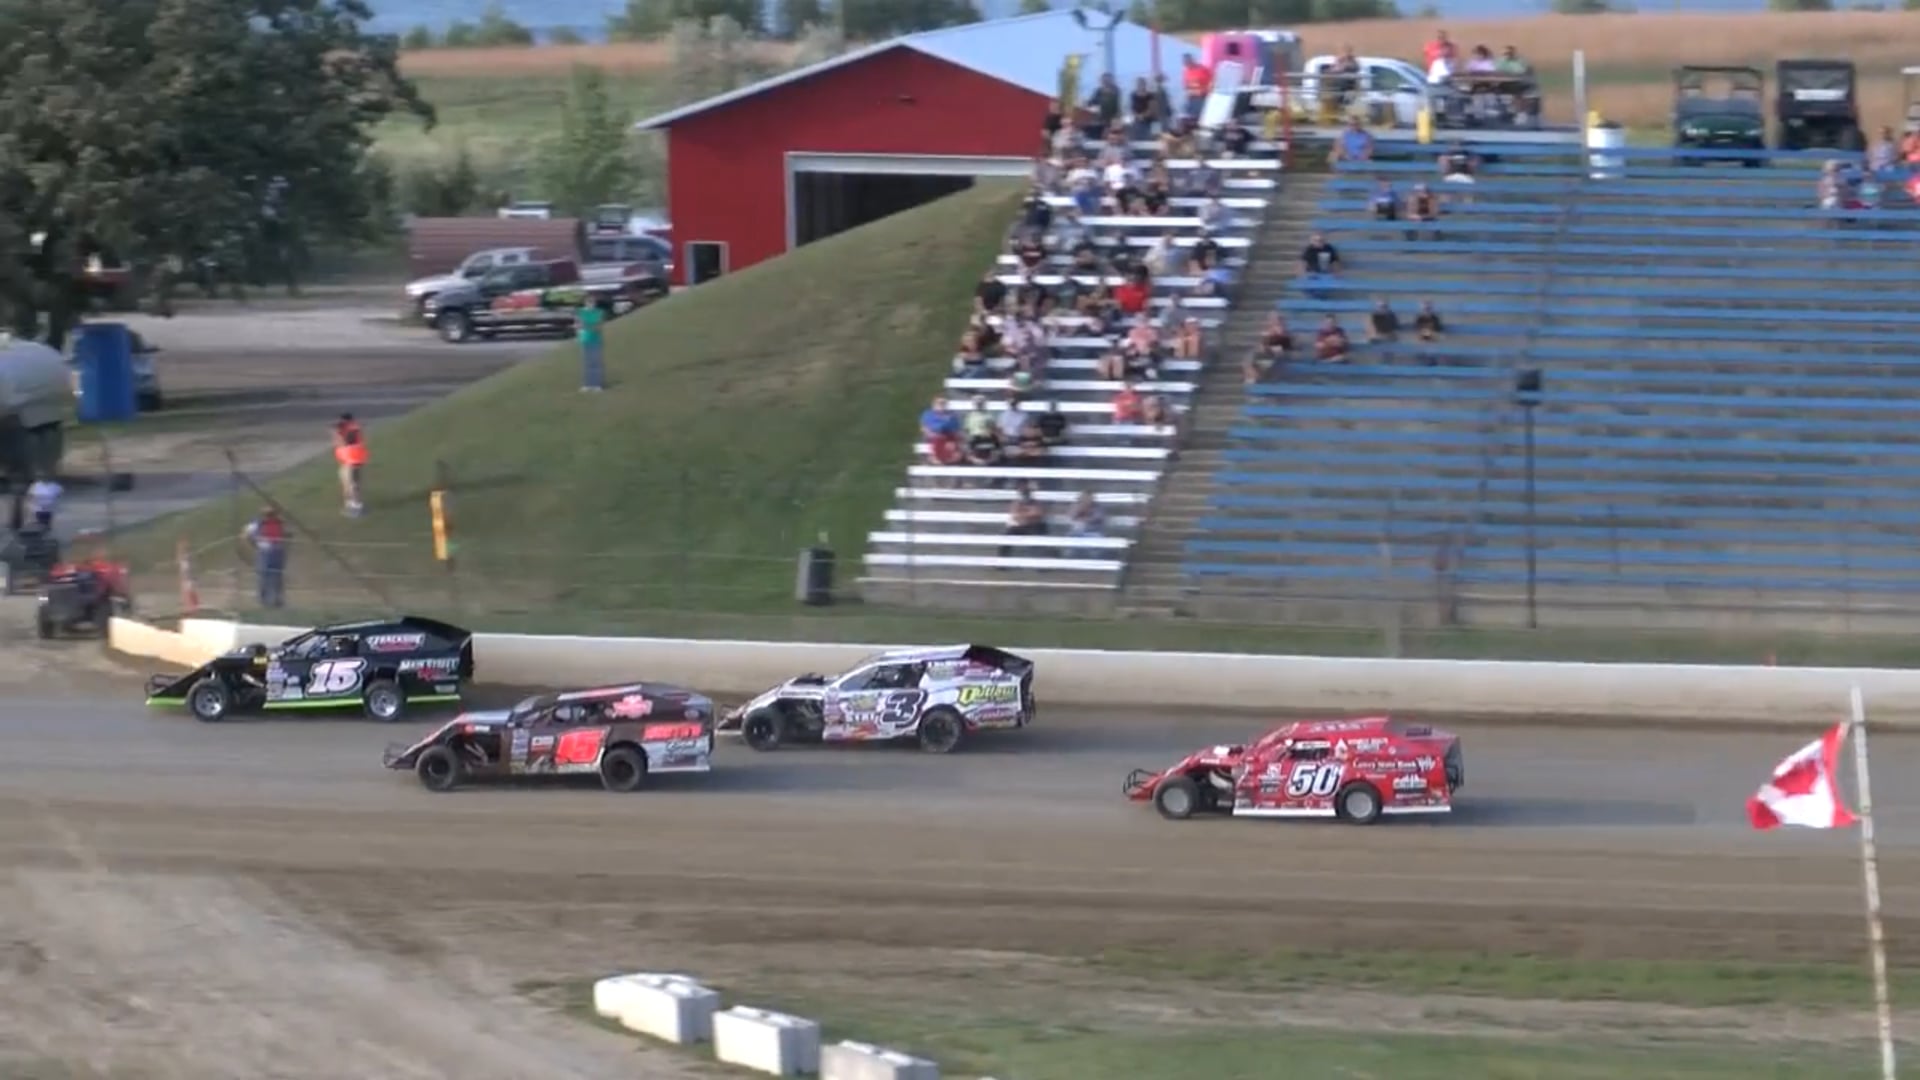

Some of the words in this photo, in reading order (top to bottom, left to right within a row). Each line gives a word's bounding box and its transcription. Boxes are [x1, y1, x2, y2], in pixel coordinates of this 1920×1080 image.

[310, 661, 363, 695] 15
[881, 689, 928, 728] 3
[1287, 762, 1342, 797] 50
